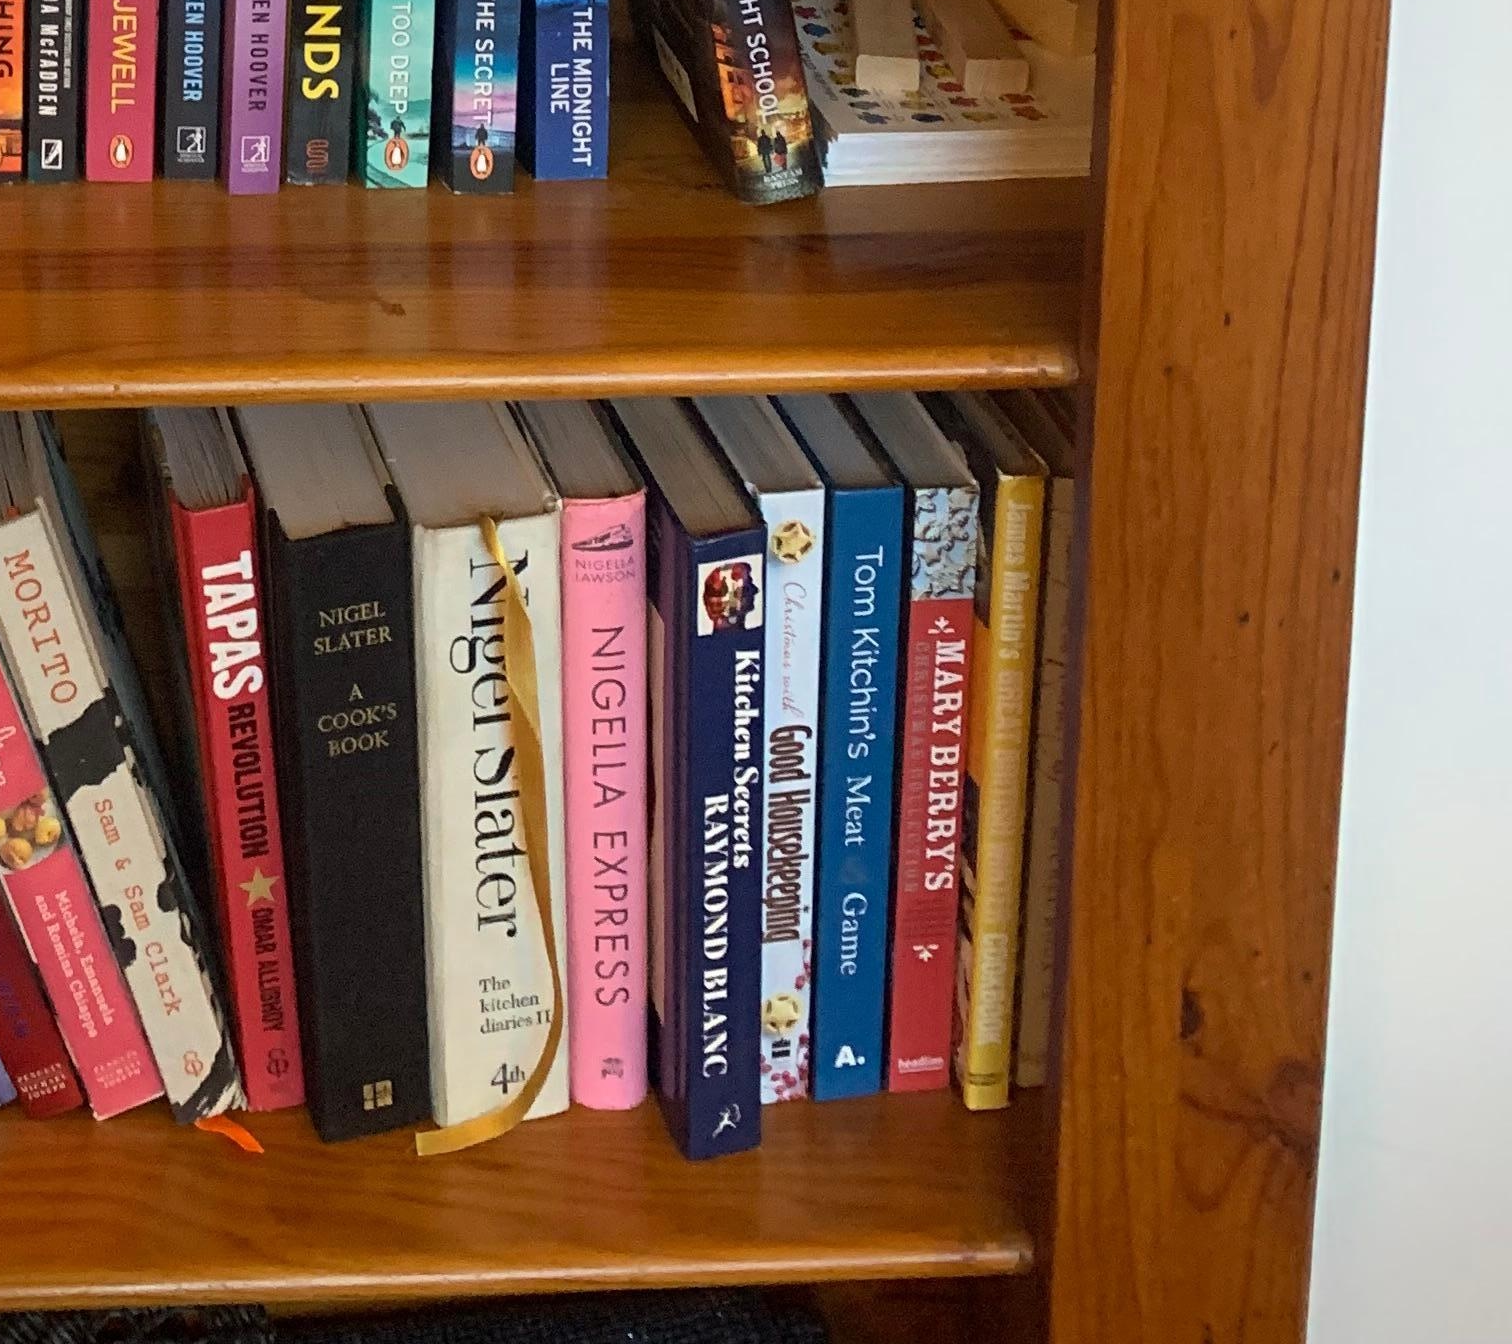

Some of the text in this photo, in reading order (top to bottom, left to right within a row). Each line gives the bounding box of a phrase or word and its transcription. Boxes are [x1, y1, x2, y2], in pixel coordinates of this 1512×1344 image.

[248, 33, 271, 111] HOOVER
[745, 32, 779, 123] SCHOOL
[1, 550, 78, 706] MORITO
[200, 550, 269, 858] TAPAS REVOLUTION
[847, 546, 884, 758] Tom Kitchin's
[590, 626, 630, 1006] NIGELLA EXPRESS
[731, 649, 759, 868] Kitchen Secrets
[762, 724, 813, 942] Good Housekeeping
[924, 639, 966, 891] MARY BERRY'S
[94, 799, 183, 1017] Sam & Sam Clark
[701, 793, 730, 1078] RAYMOND BLANC
